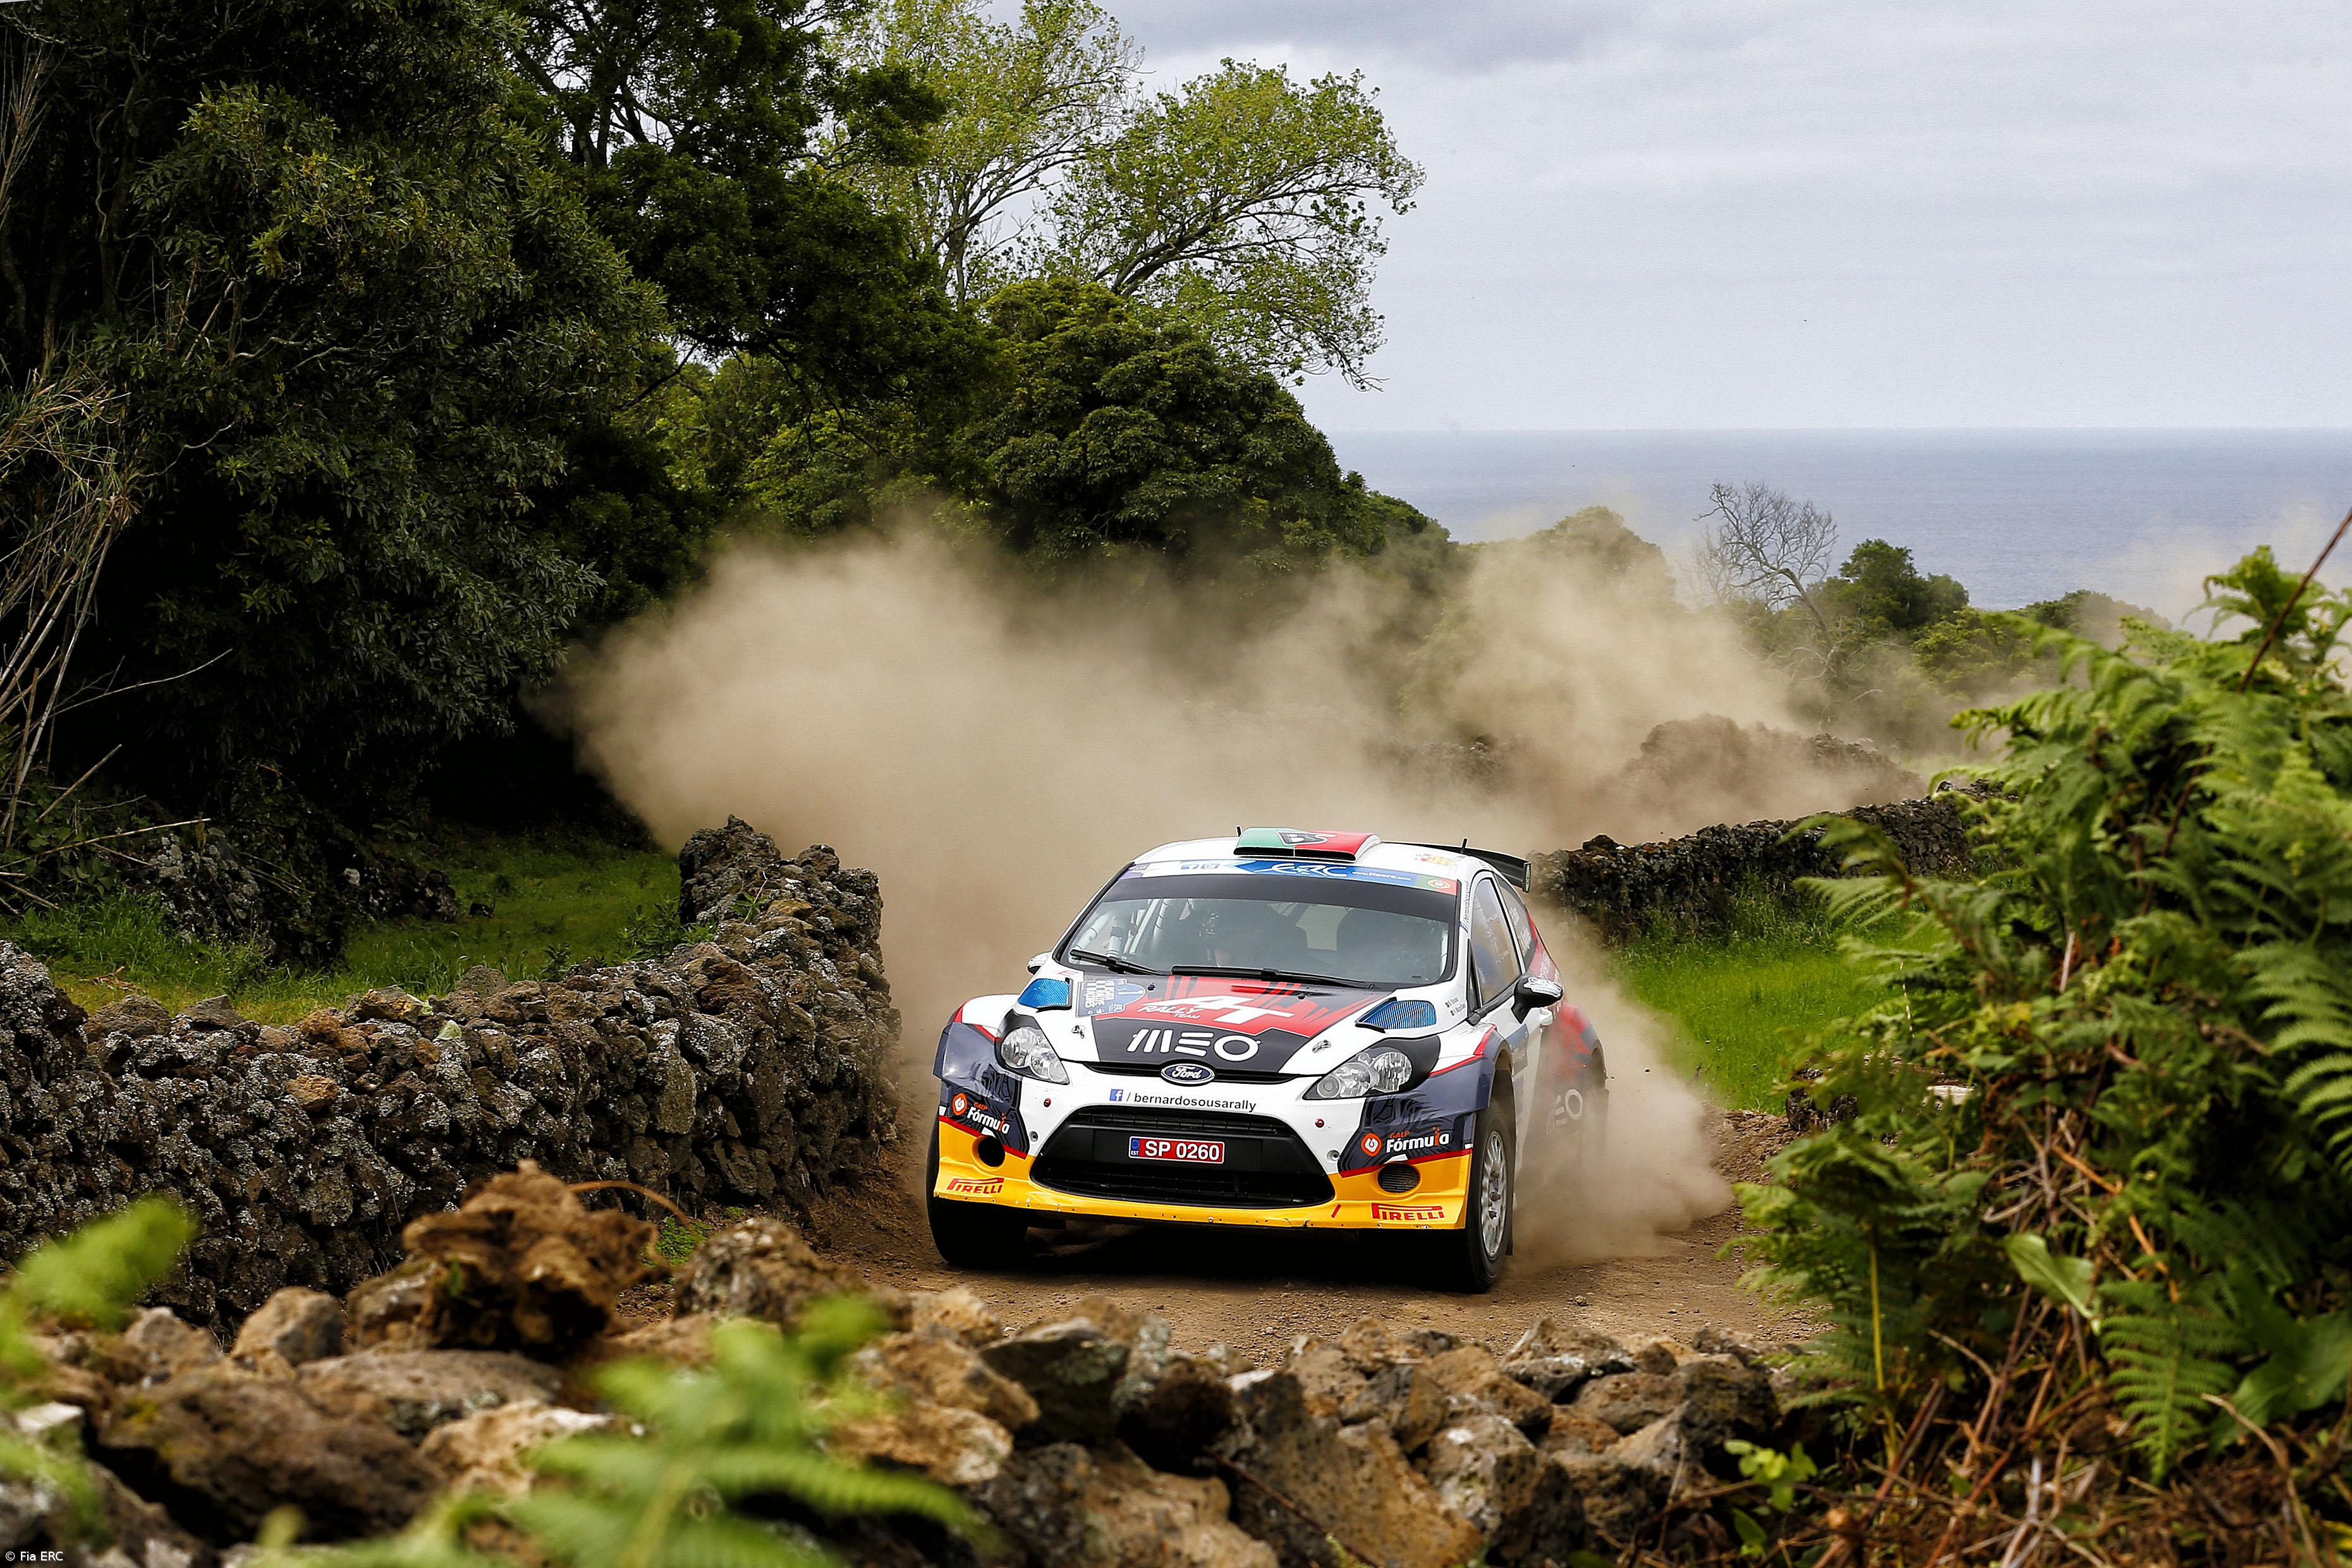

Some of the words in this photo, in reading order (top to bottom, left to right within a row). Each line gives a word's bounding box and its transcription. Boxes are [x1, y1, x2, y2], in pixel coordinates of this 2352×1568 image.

[1259, 863, 1348, 877] ERC
[1138, 1005, 1204, 1014] RALLY
[1126, 1029, 1259, 1062] MEO
[1172, 1066, 1202, 1079] Ford
[973, 1102, 989, 1111] GALP
[1134, 1093, 1257, 1112] bernardosousarally
[1391, 1130, 1410, 1138] GALP
[1145, 1140, 1171, 1157] SP
[1176, 1143, 1220, 1160] 0260
[947, 1177, 1004, 1194] PIRELLI
[1372, 1203, 1444, 1220] PIRELLI
